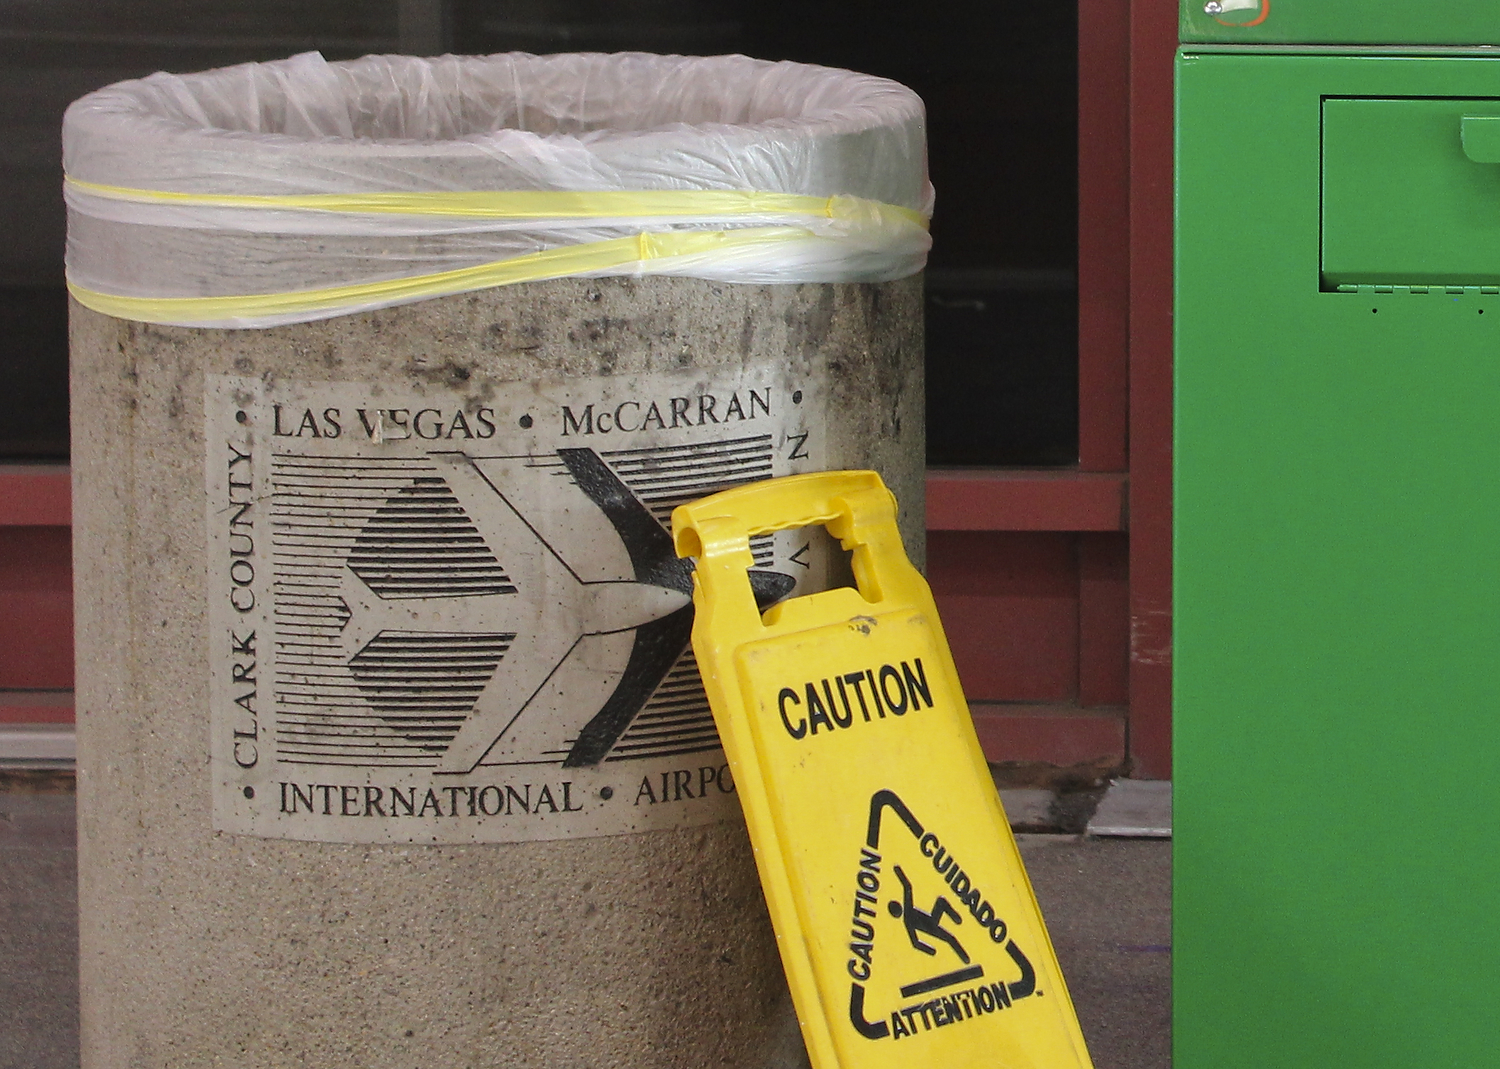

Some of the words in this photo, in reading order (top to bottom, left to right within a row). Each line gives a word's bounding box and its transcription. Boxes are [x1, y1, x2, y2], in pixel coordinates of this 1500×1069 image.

[272, 404, 341, 439] LAS
[355, 407, 497, 441] VEGAS
[561, 387, 772, 436] McCARRAN
[228, 442, 255, 614] COUNTY
[232, 630, 259, 769] CLARK
[778, 657, 934, 740] CAUTION
[279, 781, 584, 818] INTERNATIONAL
[847, 848, 882, 981] CAUTION
[920, 832, 1008, 943] CUIDADO
[891, 981, 1012, 1040] ATTENTION
